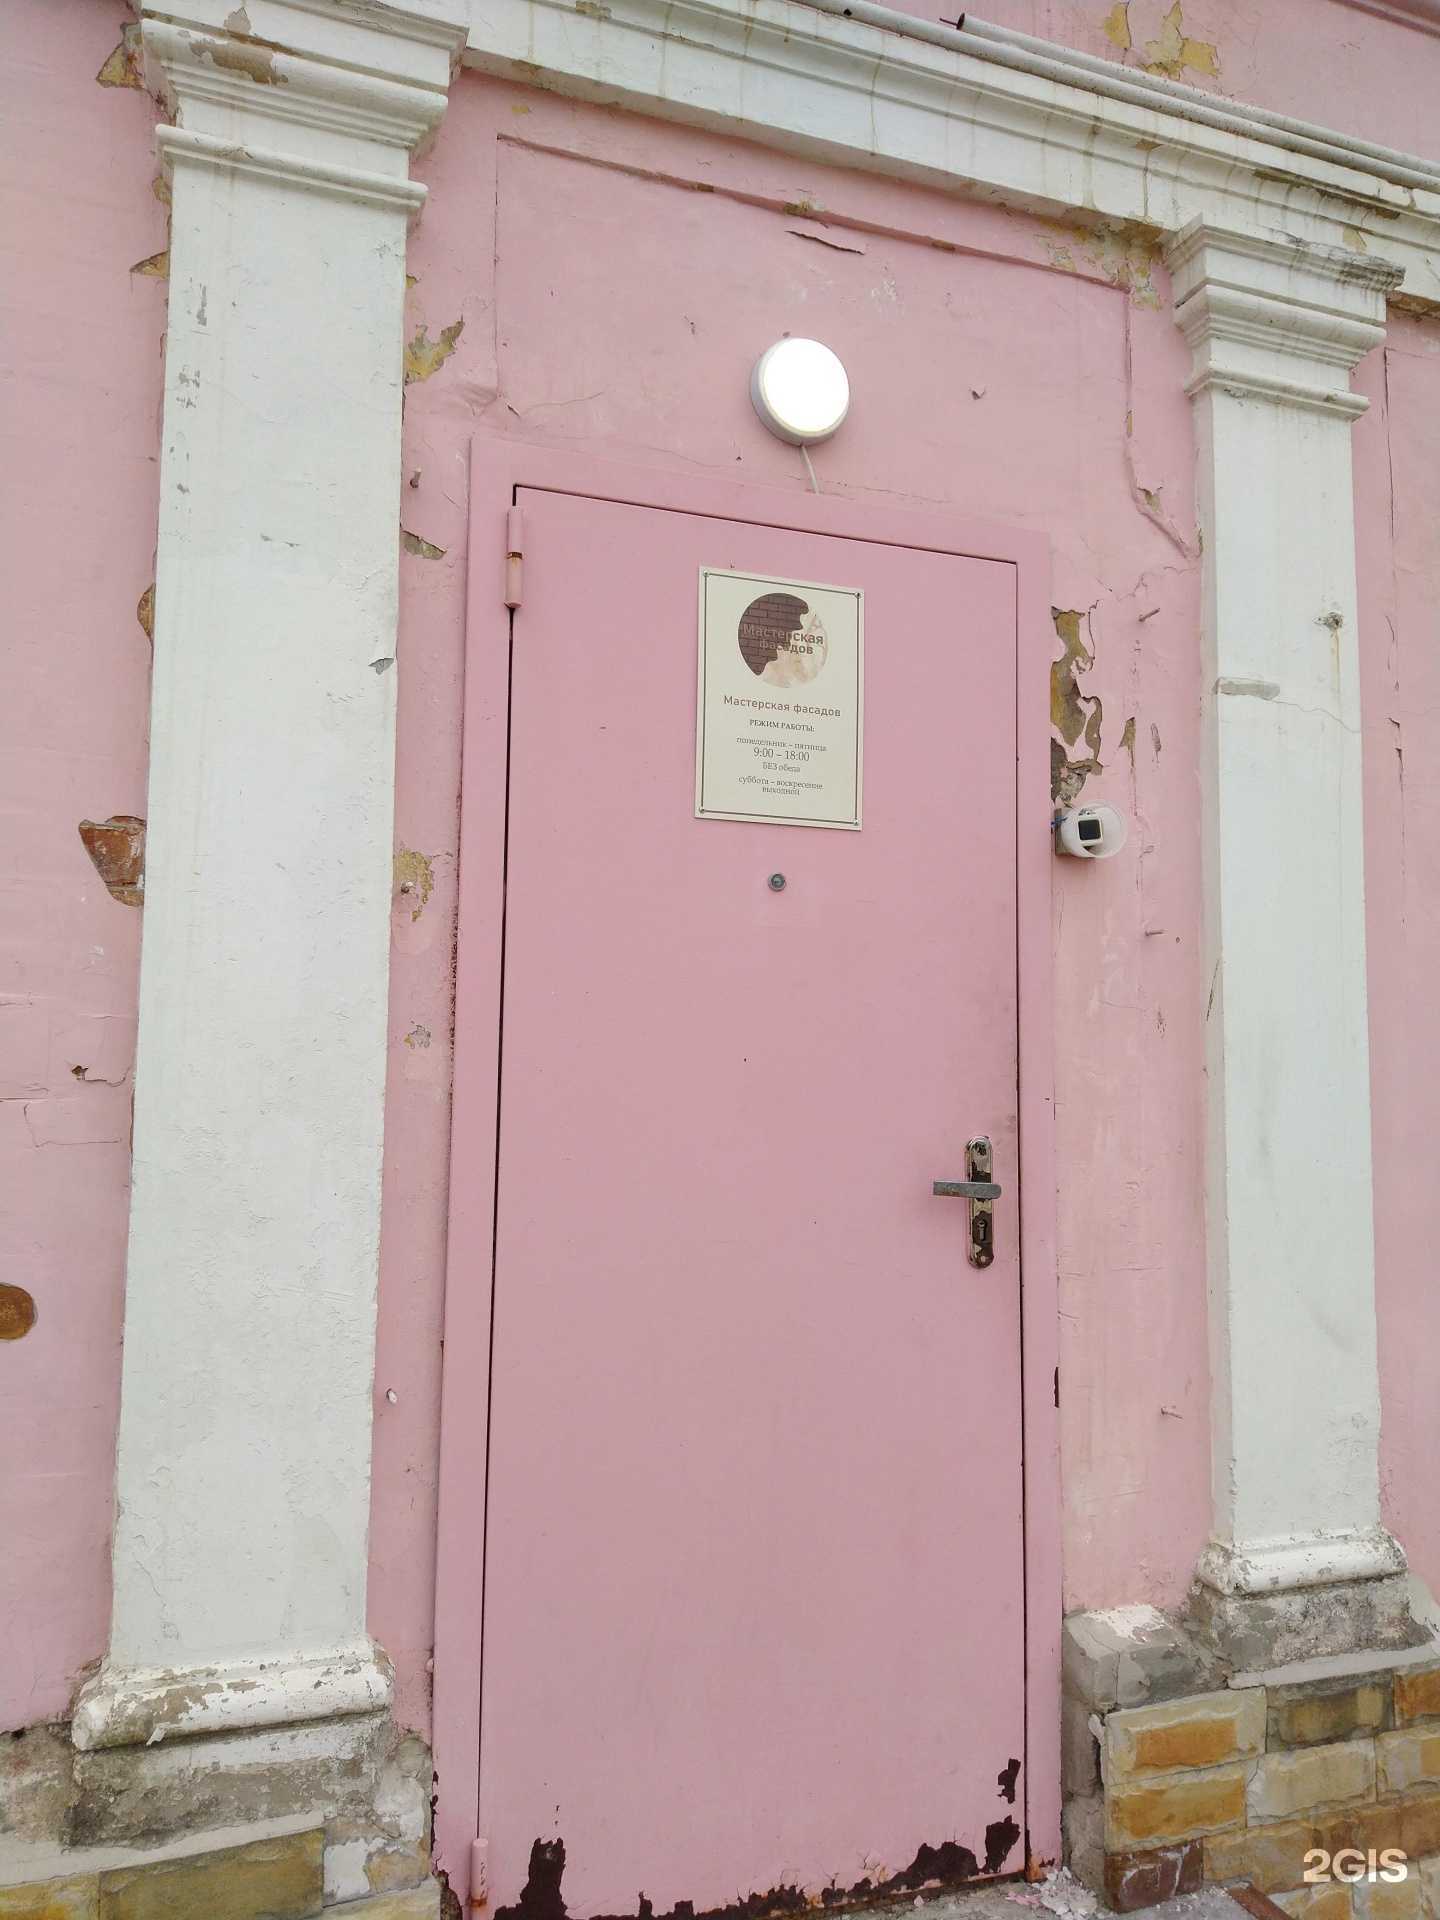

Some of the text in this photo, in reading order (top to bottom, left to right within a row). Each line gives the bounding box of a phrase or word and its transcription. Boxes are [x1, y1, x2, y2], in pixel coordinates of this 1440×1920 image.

[723, 695, 841, 717] Мастерская фасадов
[749, 718, 815, 732] РЕЖИМ РАБОТЫ:
[736, 737, 787, 748] понедельник
[794, 742, 827, 752] пятница
[753, 746, 774, 758] 9:00
[785, 750, 810, 762] 18:00
[738, 775, 769, 785] суббота
[762, 786, 800, 797] выходной
